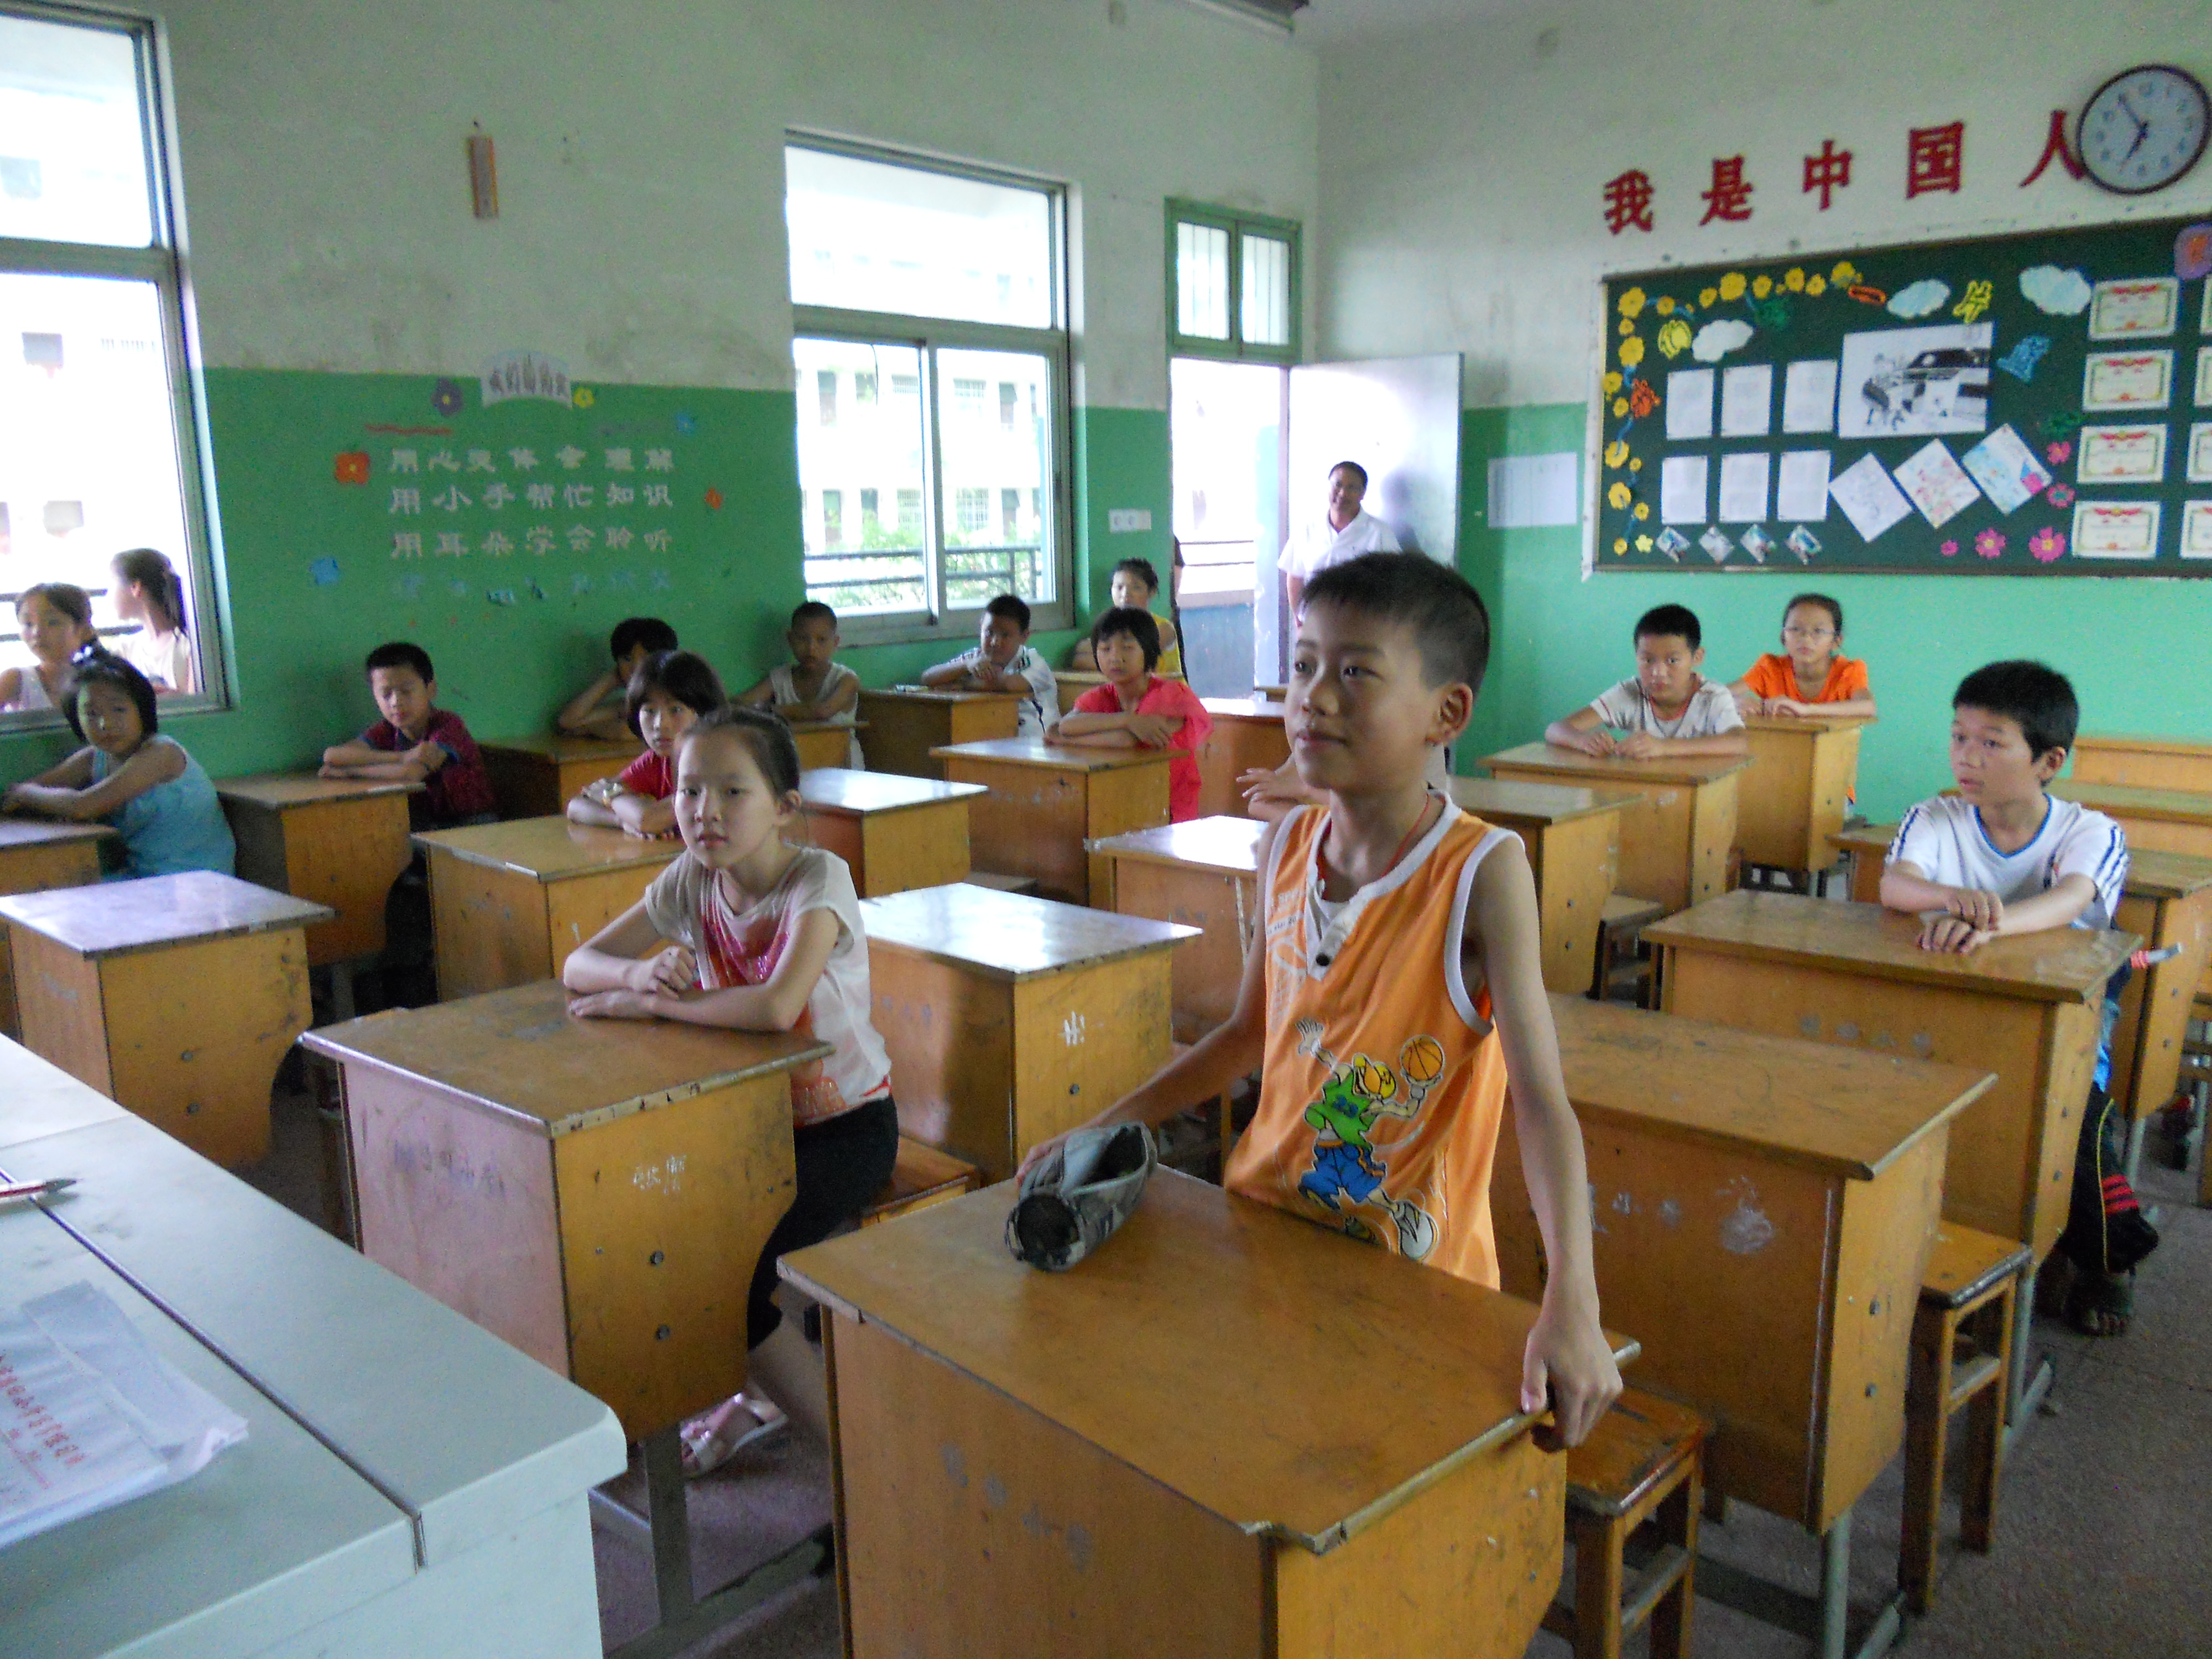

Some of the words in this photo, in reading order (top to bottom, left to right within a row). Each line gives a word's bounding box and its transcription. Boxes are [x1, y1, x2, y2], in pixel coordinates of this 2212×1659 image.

[1603, 109, 2084, 234] 我是中国人
